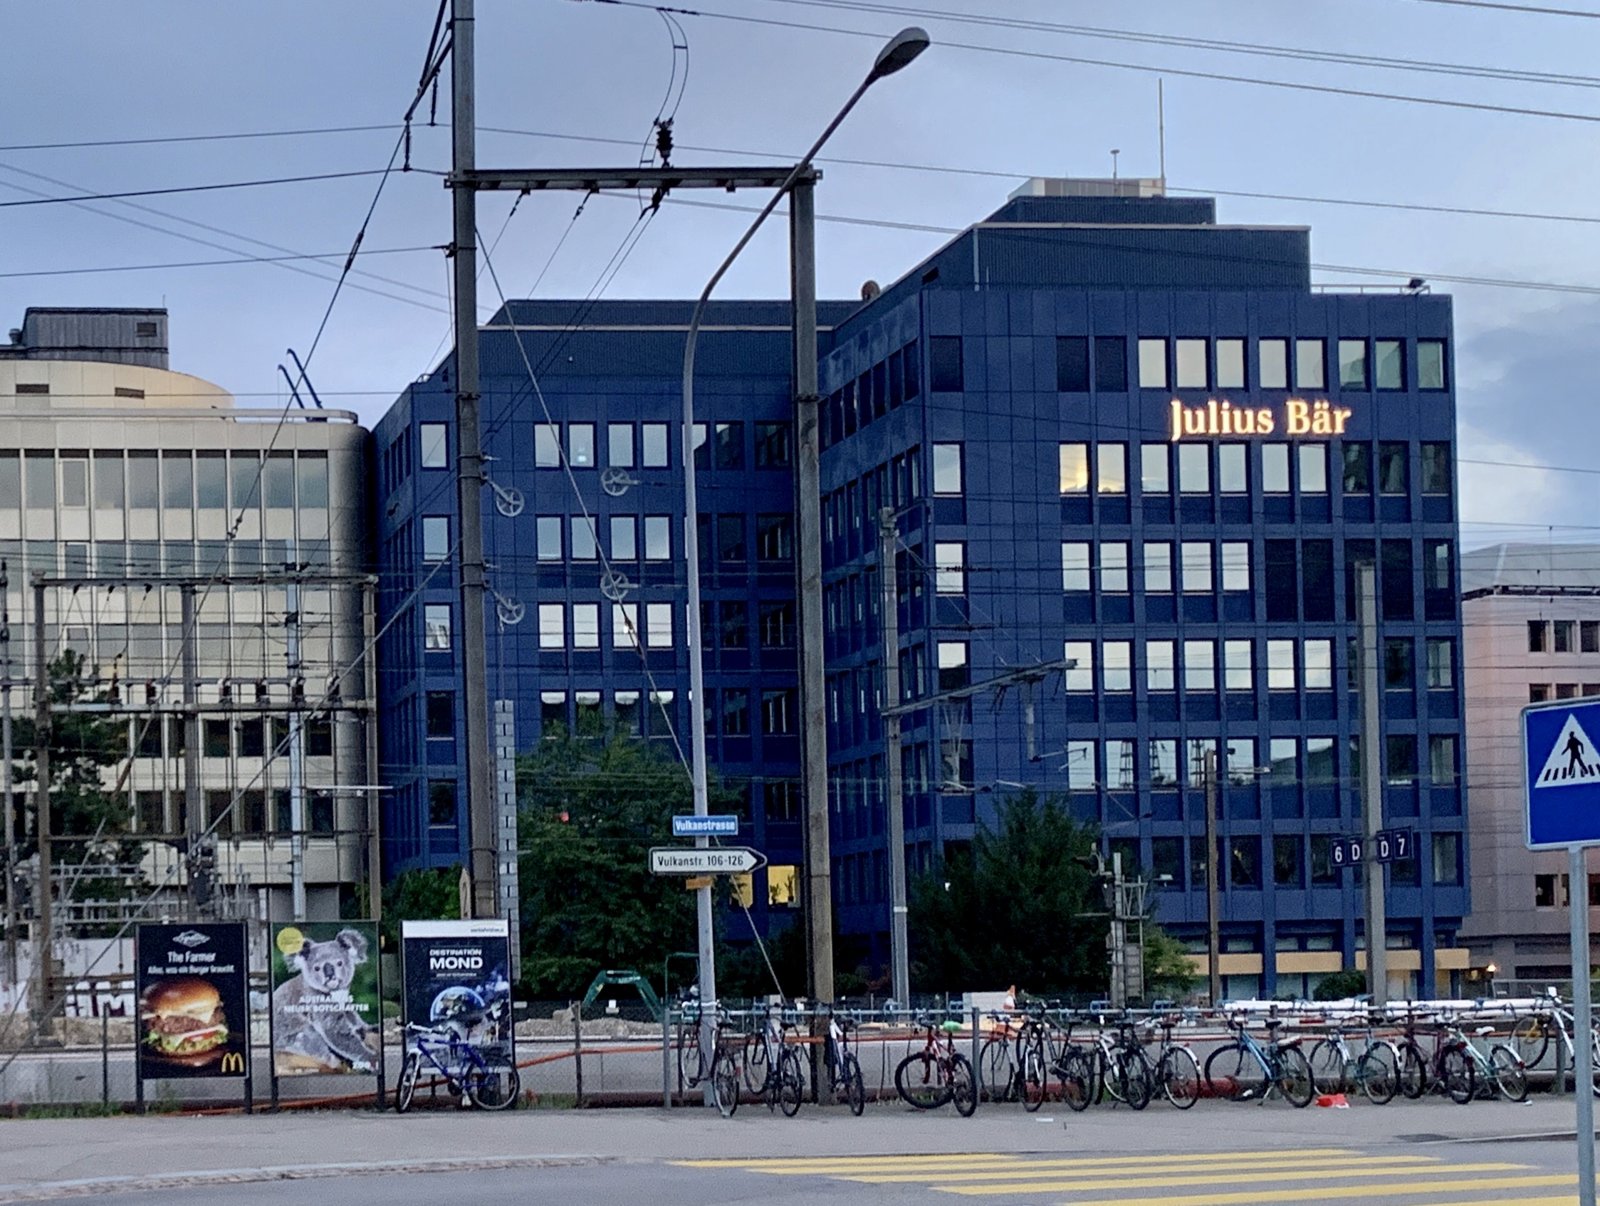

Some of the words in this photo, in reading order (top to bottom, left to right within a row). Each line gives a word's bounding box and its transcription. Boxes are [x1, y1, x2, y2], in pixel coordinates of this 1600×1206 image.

[1170, 399, 1274, 441] Julius
[1286, 399, 1351, 433] Bär
[675, 820, 735, 831] Vulkanstrasse
[1334, 846, 1342, 863] 6
[1351, 844, 1360, 861] D
[1380, 840, 1389, 858] D
[1398, 838, 1405, 856] 7
[658, 856, 703, 867] Vulkanstr.
[707, 855, 744, 866] 106-126
[167, 951, 184, 963] The
[185, 951, 216, 963] Farmer
[429, 948, 482, 957] DESTINATION
[430, 956, 483, 970] MOND
